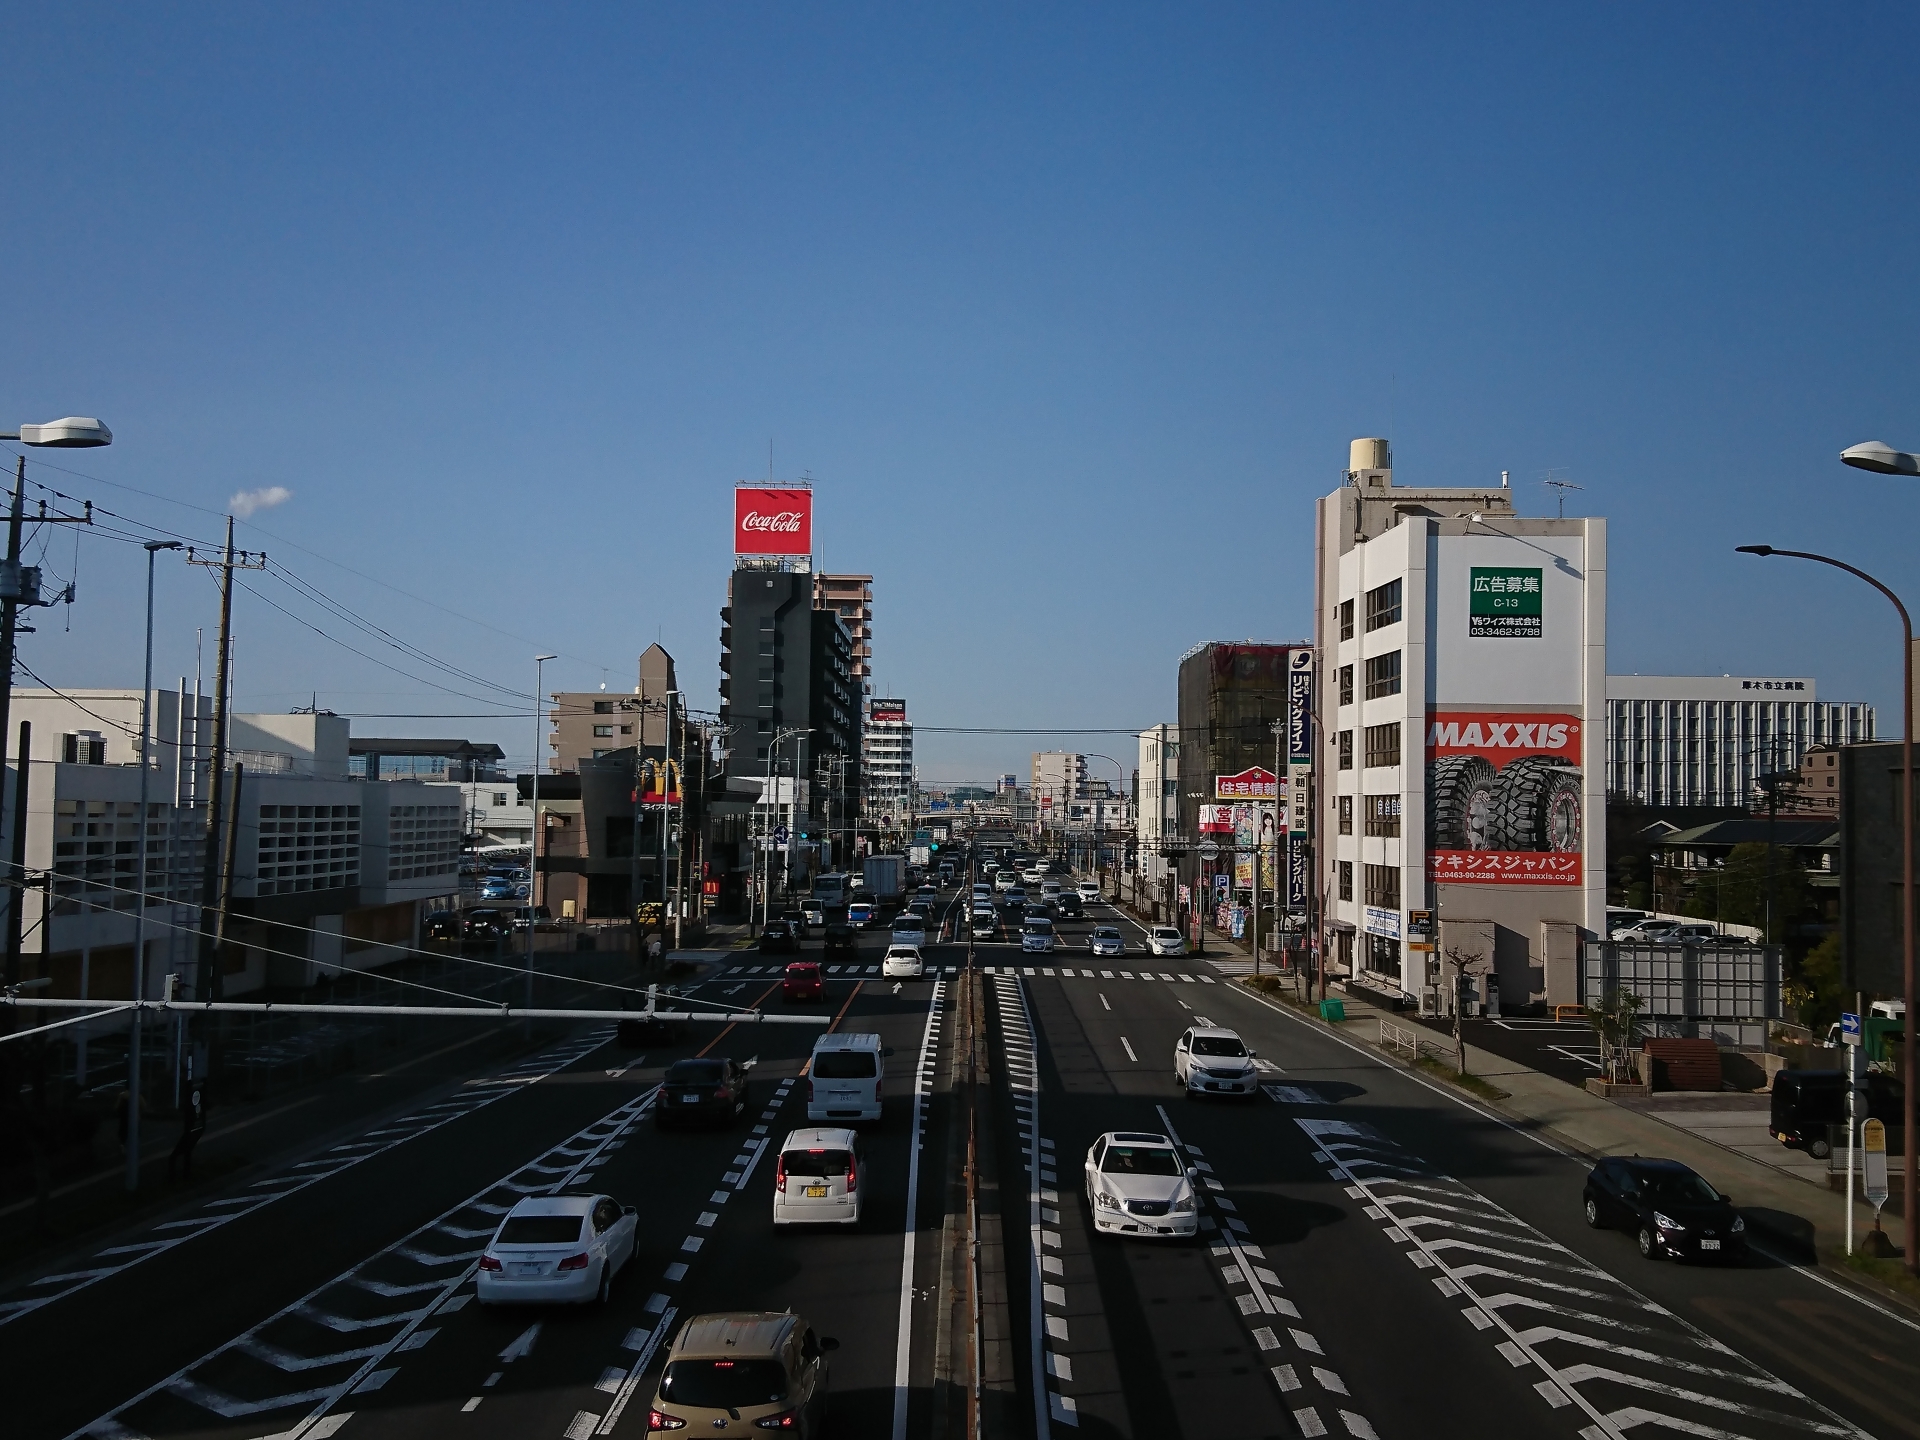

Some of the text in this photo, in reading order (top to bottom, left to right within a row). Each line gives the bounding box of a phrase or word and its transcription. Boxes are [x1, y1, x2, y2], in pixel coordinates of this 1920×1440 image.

[1473, 576, 1540, 593] 広告募集
[1494, 599, 1518, 608] C-13
[1471, 627, 1540, 636] 03-3462-8788
[1742, 681, 1805, 690] 厚木市立病院
[1291, 675, 1304, 752] リビングライフ
[1426, 722, 1568, 748] MAXXIS
[1295, 777, 1305, 828] 朝日建設
[1428, 855, 1576, 871] マキシスジャパン
[1218, 877, 1227, 886] P
[1428, 871, 1576, 882] TEL:0463-90-2288 www.maxxis.co.jp
[1412, 912, 1430, 924] P
